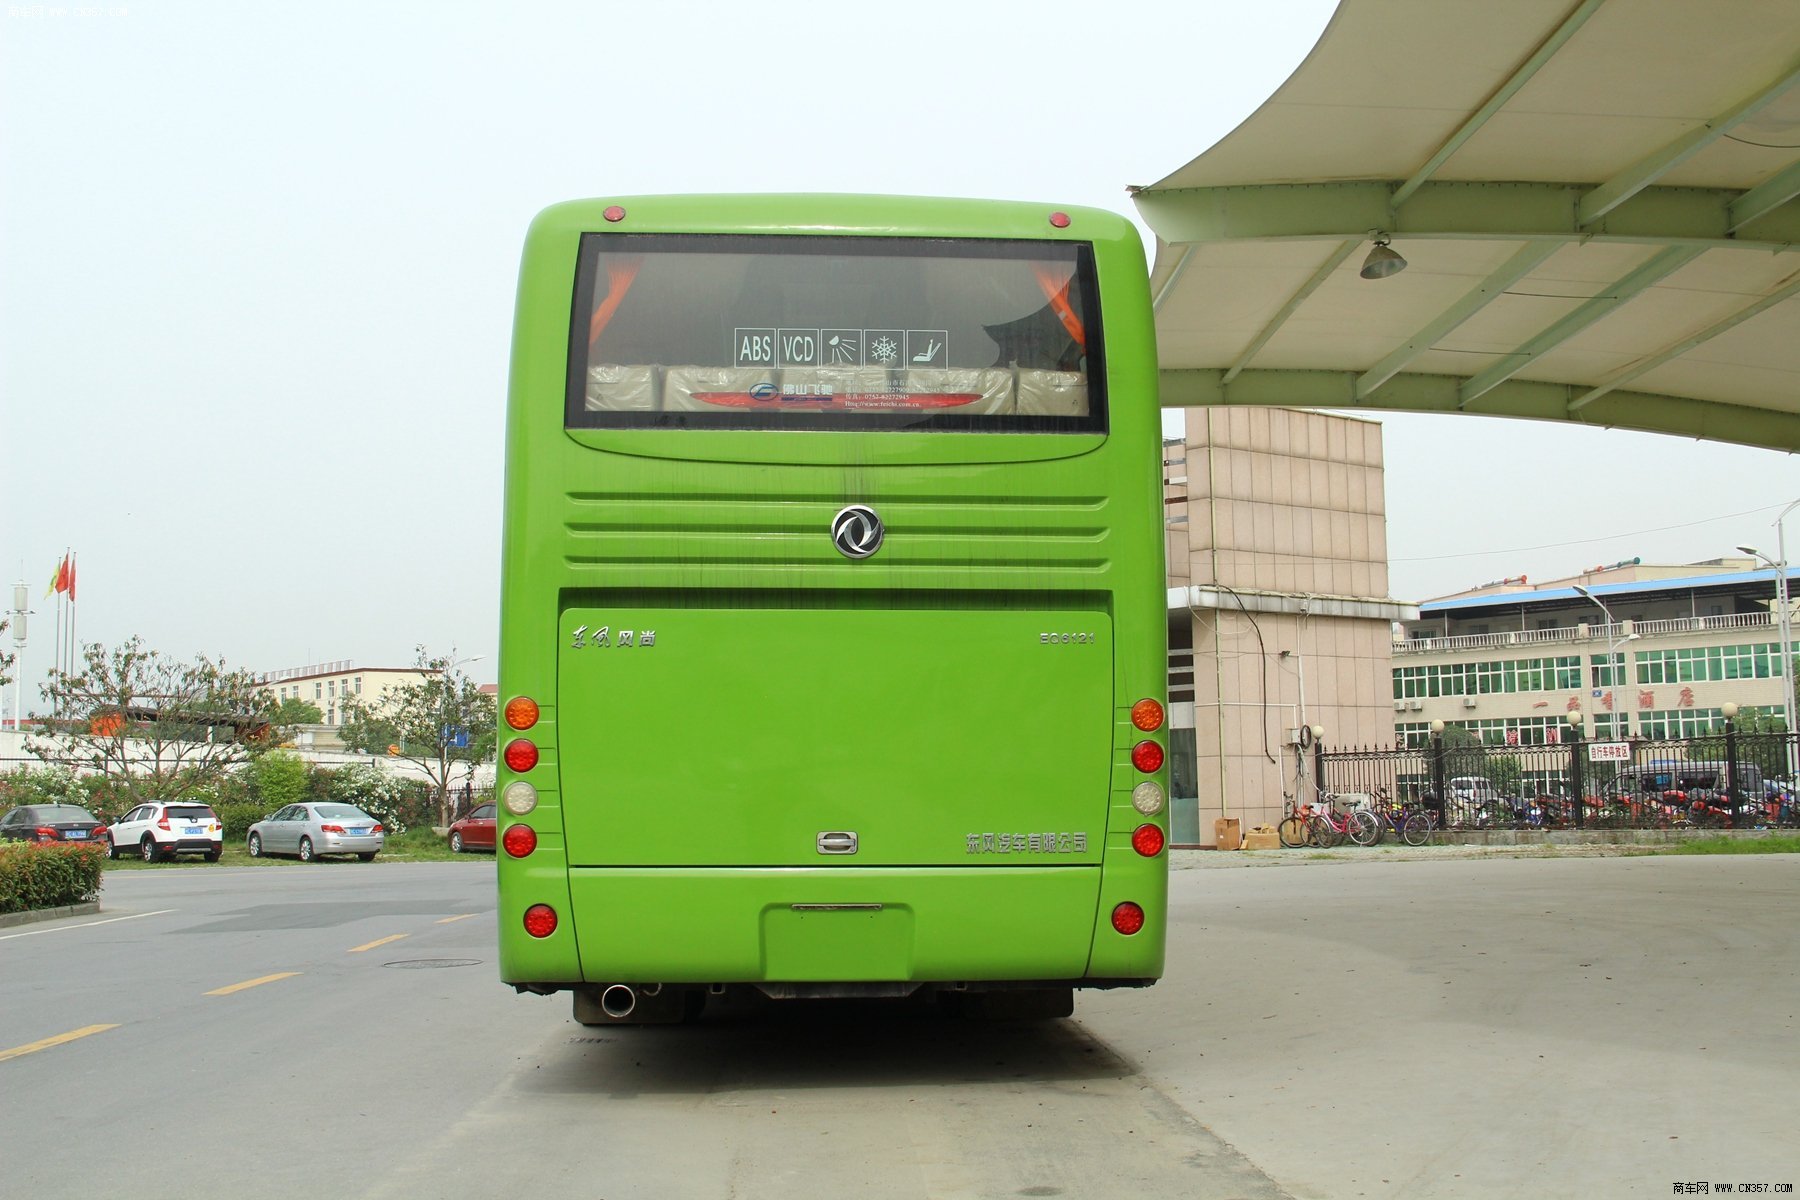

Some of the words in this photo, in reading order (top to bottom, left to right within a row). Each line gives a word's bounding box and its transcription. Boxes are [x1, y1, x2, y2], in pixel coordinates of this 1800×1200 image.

[740, 336, 771, 361] ABS
[783, 336, 814, 361] VCD
[783, 384, 833, 396] 佛山飞驰
[1040, 632, 1095, 644] EQ6121
[1591, 745, 1628, 759] 自行车停放区
[966, 832, 1088, 853] 东风汽车有限公司
